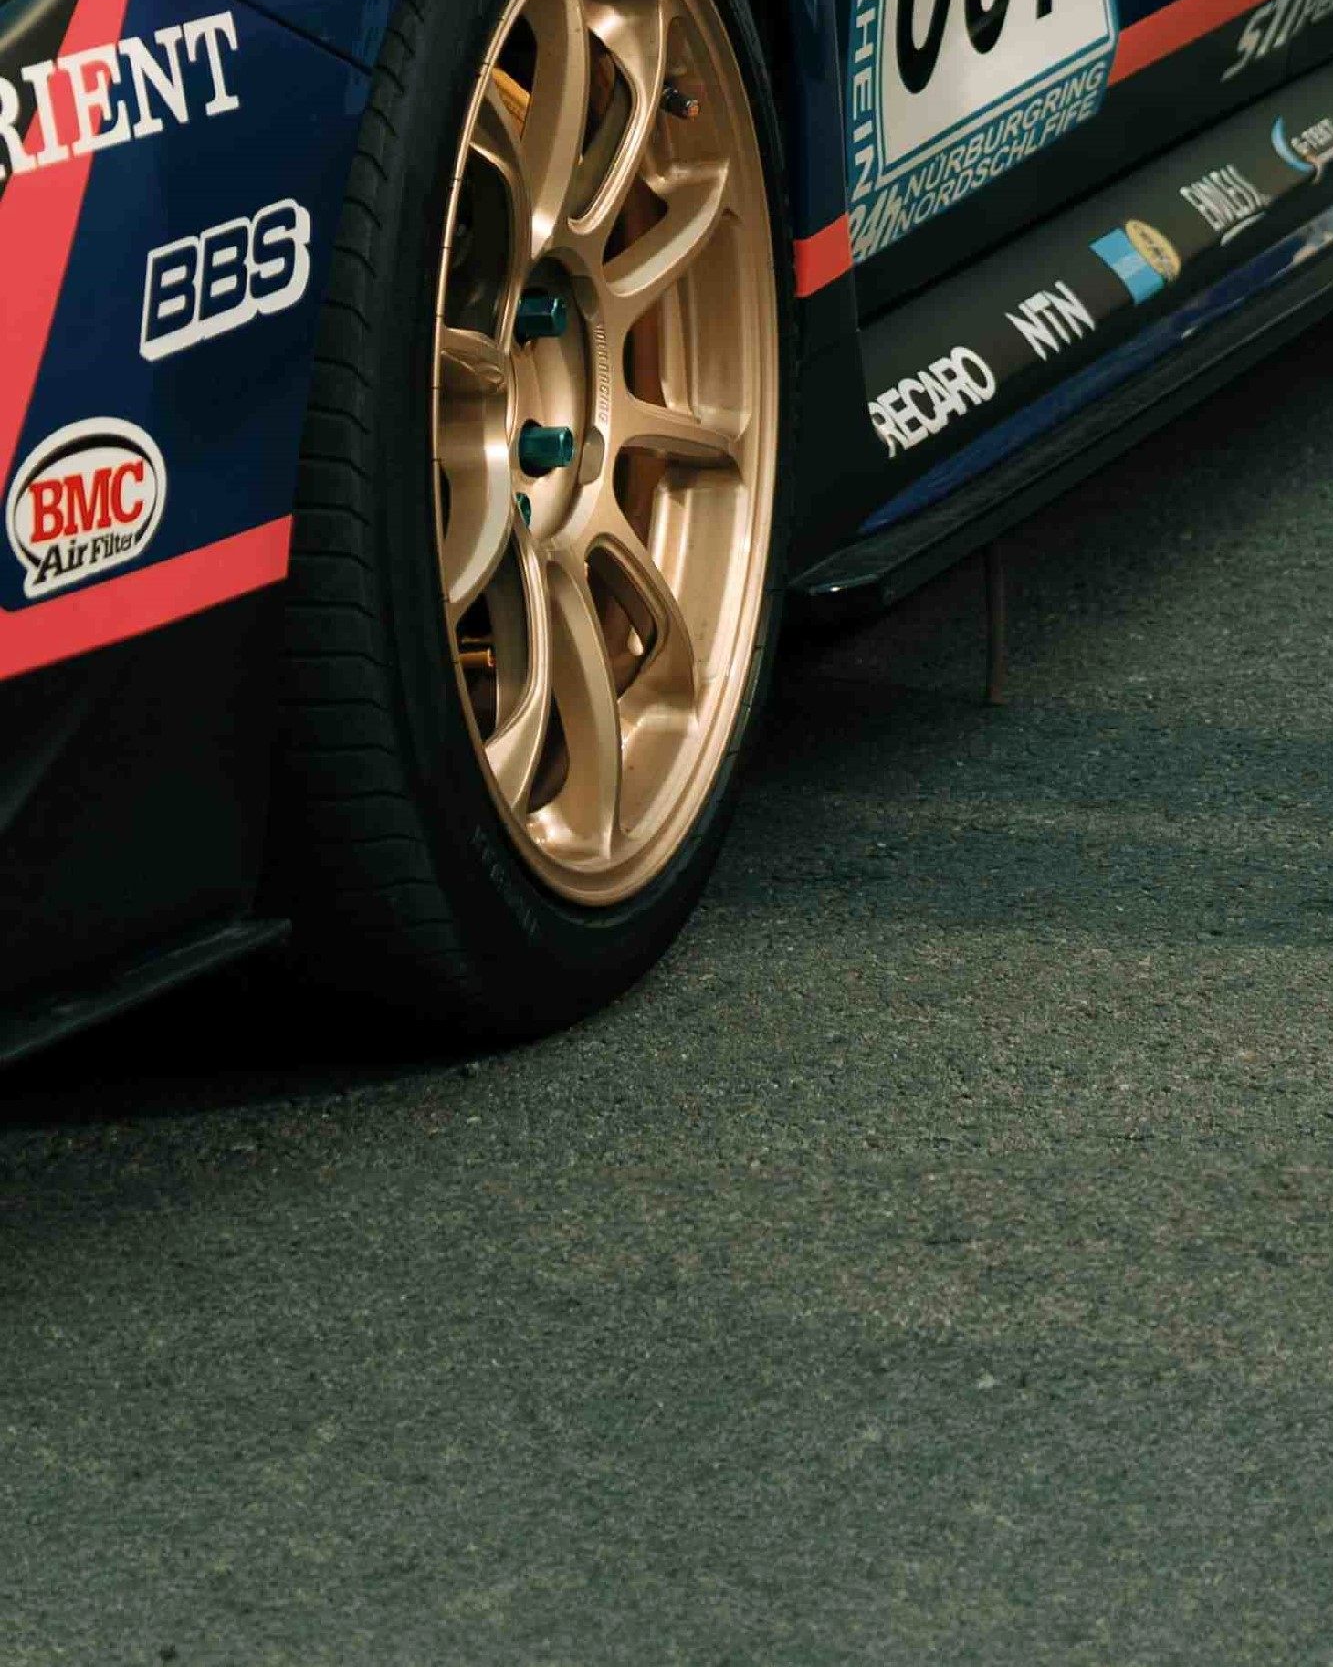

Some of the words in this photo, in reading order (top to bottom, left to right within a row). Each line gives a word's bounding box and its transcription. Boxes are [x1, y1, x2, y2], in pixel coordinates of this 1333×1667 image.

[903, 60, 1106, 203] NÜRBURGRING
[140, 198, 311, 361] BBS
[1004, 280, 1097, 362] NTN
[868, 346, 997, 458] RECARO
[28, 455, 145, 544] BMC
[32, 539, 88, 585] Air
